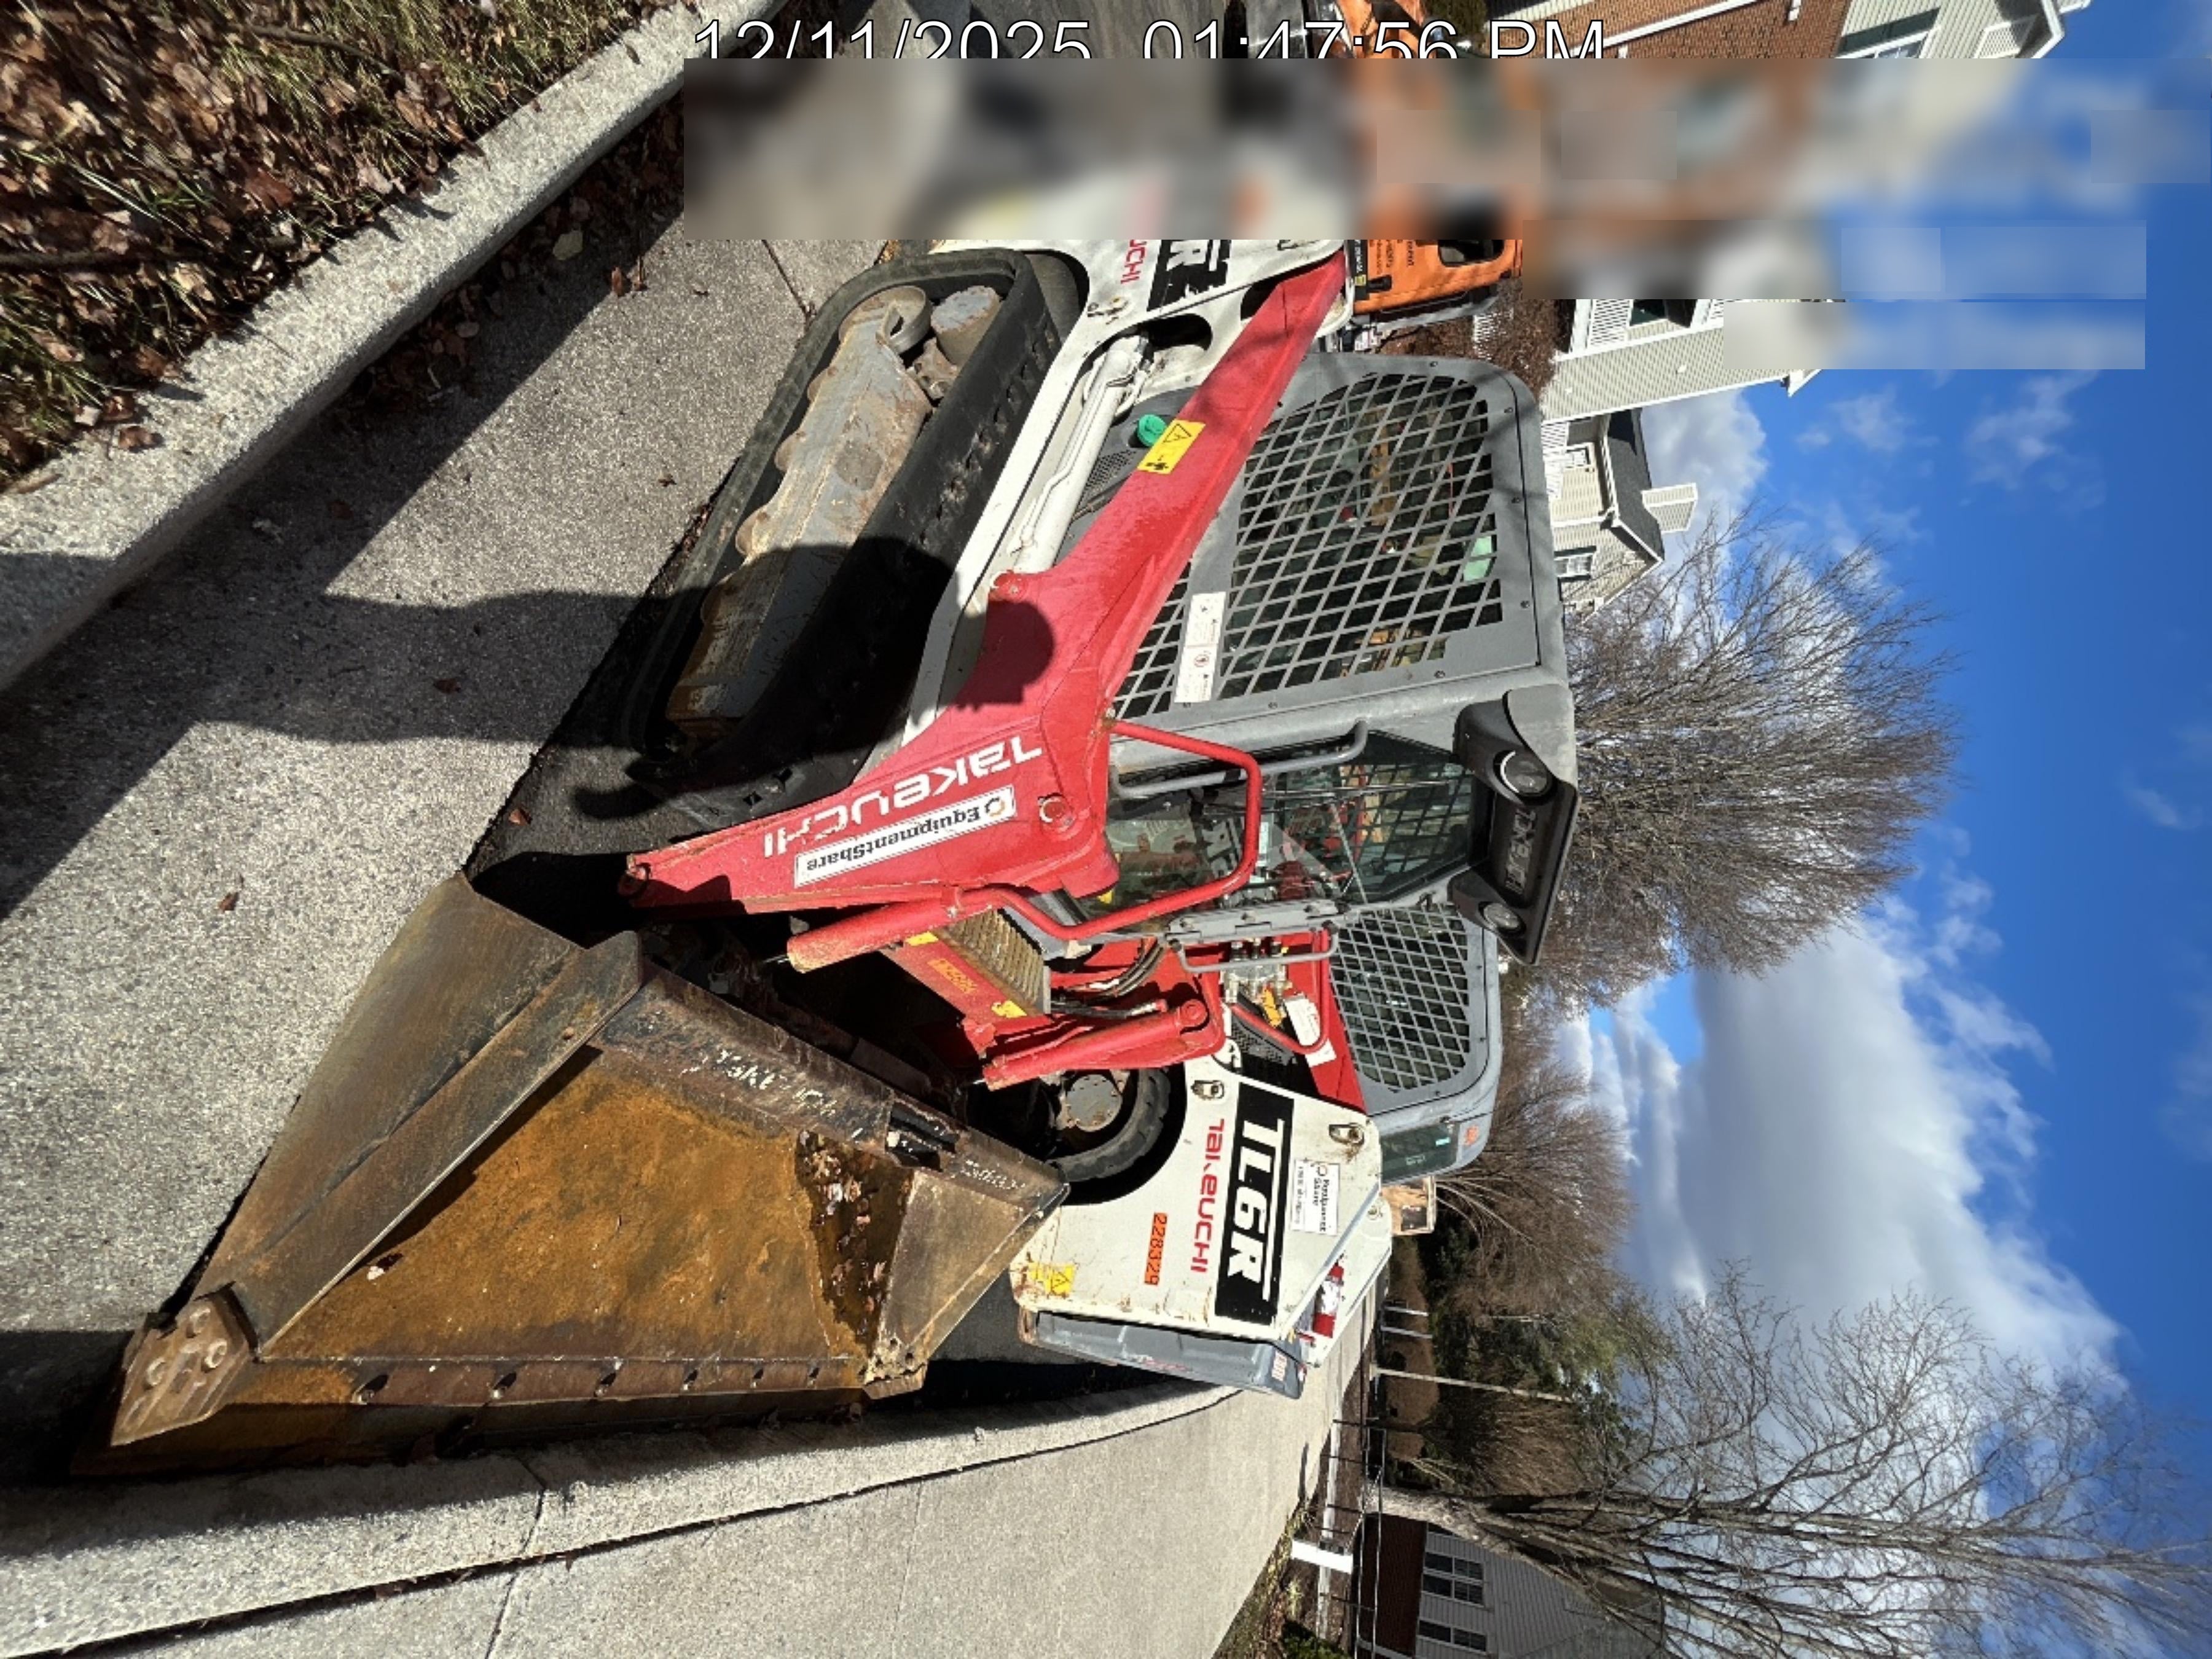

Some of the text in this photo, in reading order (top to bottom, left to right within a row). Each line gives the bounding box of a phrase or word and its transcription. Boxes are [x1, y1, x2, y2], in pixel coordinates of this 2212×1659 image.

[806, 806, 982, 873] EquipmentShare
[1145, 1214, 1167, 1285] 228329
[1190, 1118, 1225, 1273] TAKEUCHI
[1228, 1118, 1285, 1301] TL6R
